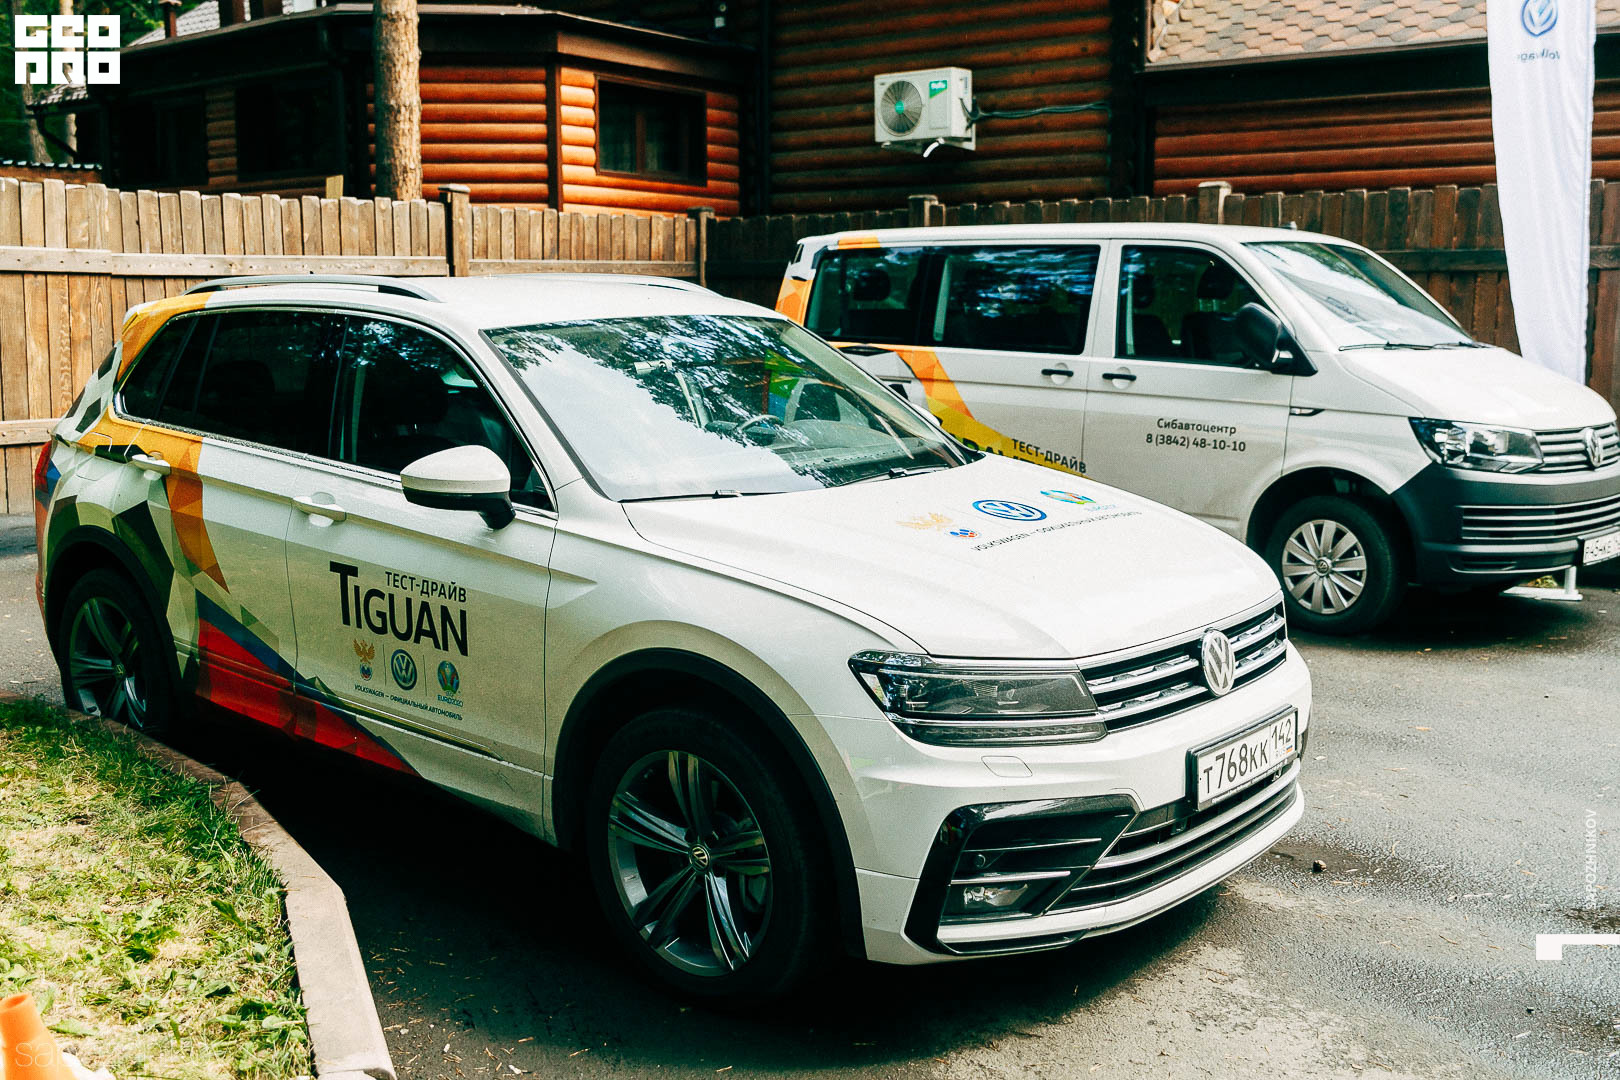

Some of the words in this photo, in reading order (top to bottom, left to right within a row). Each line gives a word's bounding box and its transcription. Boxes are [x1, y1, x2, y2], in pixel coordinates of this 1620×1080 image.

[1156, 418, 1237, 436] Сибавтоцентр
[1145, 433, 1153, 443] 8
[1155, 434, 1190, 449] (3842)
[1192, 437, 1246, 452] 48-10-10
[1011, 438, 1087, 474] ТЕСТ-ДРАЙВ
[385, 571, 467, 603] ТЕСТ-ДРАЙВ
[354, 684, 385, 698] VOLKSWAGEN
